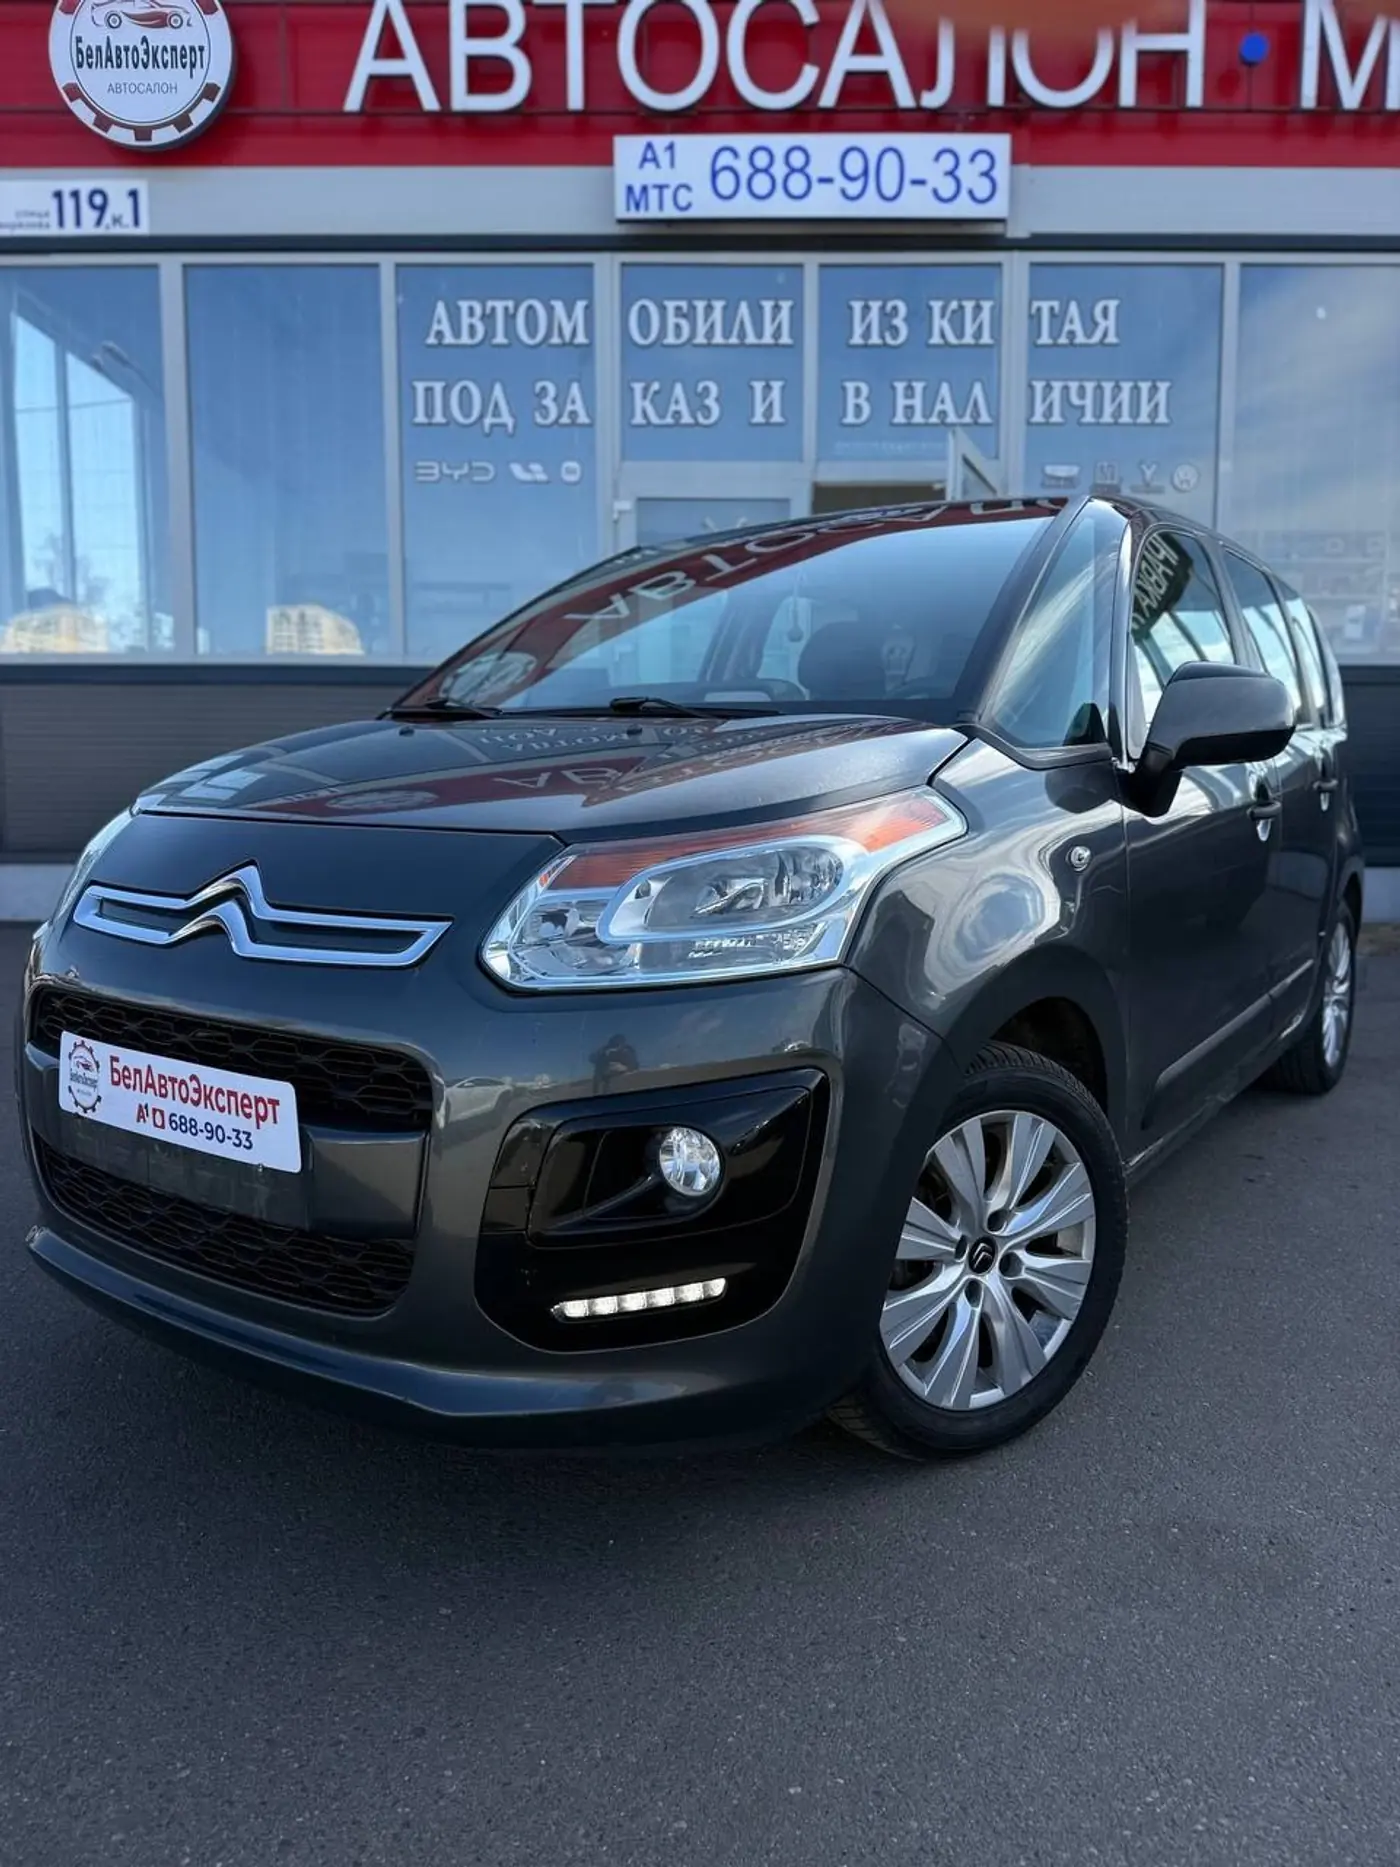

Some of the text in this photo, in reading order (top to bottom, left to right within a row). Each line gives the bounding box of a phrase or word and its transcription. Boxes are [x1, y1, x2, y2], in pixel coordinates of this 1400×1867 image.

[75, 36, 206, 79] БелАвтоЭксперт
[343, 0, 1206, 112] АВТОСАЛОН
[107, 82, 178, 95] АВТОСАЛОН
[638, 141, 676, 170] A1
[710, 145, 998, 204] 688-90-33
[625, 184, 693, 212] МТС
[848, 299, 909, 346] ИЗ
[412, 380, 516, 435] ПОД
[749, 380, 785, 425] И
[841, 380, 871, 425] В
[109, 1055, 280, 1129] БелАвтоЭксперт
[168, 1112, 253, 1150] 688-90-33
